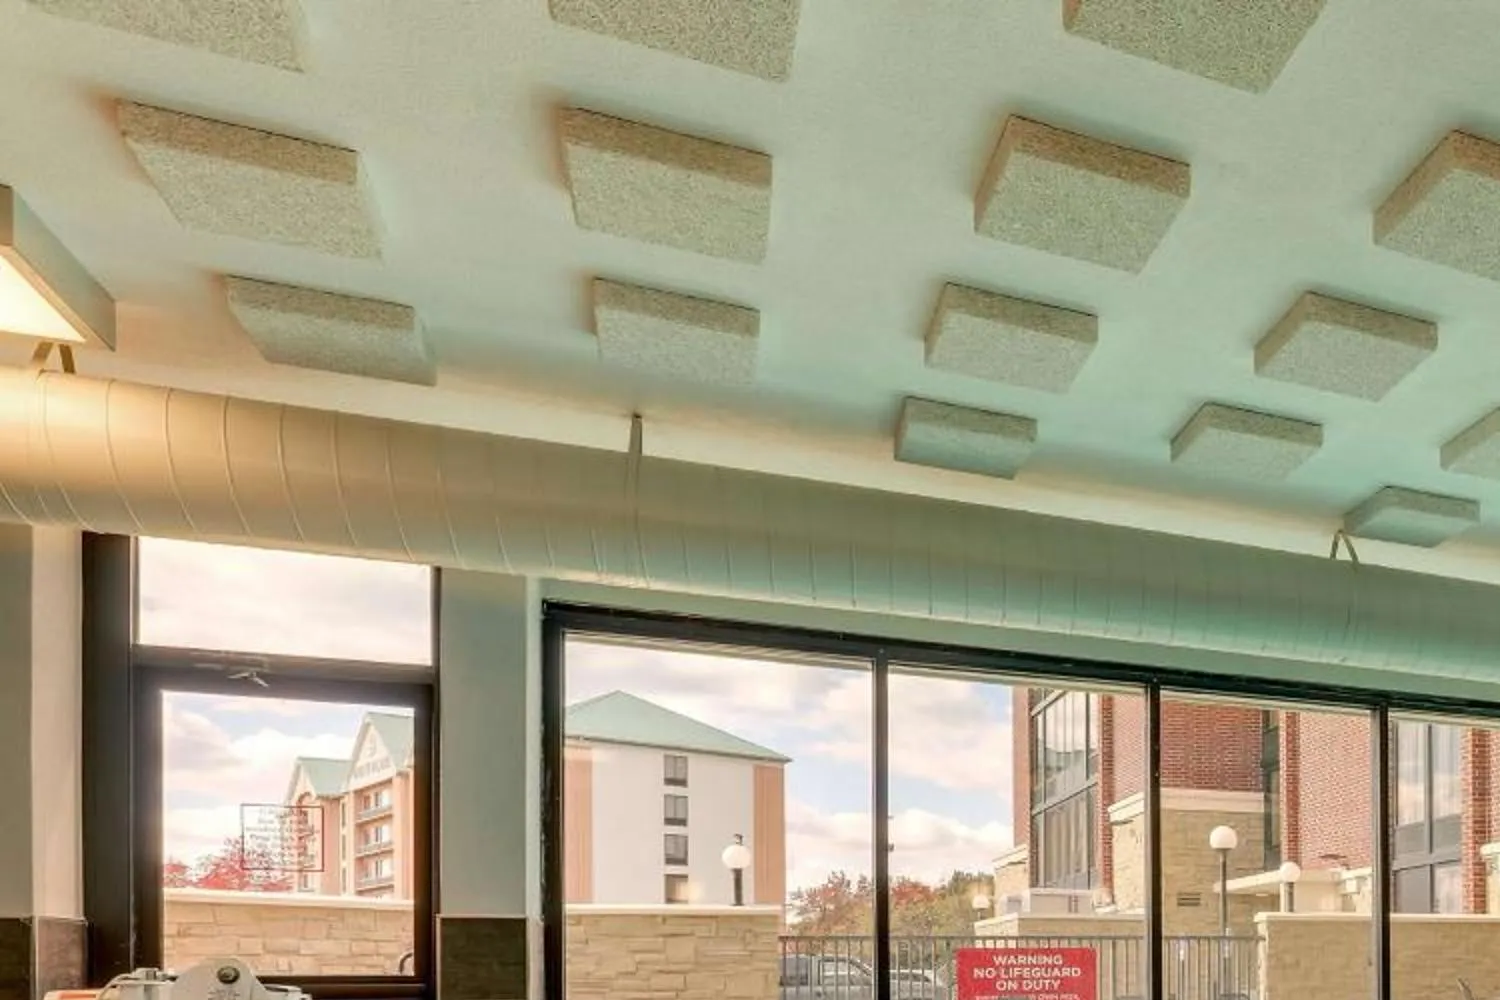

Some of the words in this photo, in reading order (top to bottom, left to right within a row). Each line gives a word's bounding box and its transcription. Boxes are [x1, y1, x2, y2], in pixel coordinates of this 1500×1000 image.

[992, 953, 1063, 966] WARNING
[972, 967, 996, 979] NO
[1000, 966, 1082, 978] LIFEGUARD
[995, 979, 1018, 991] ON
[1022, 979, 1061, 991] DUTY
